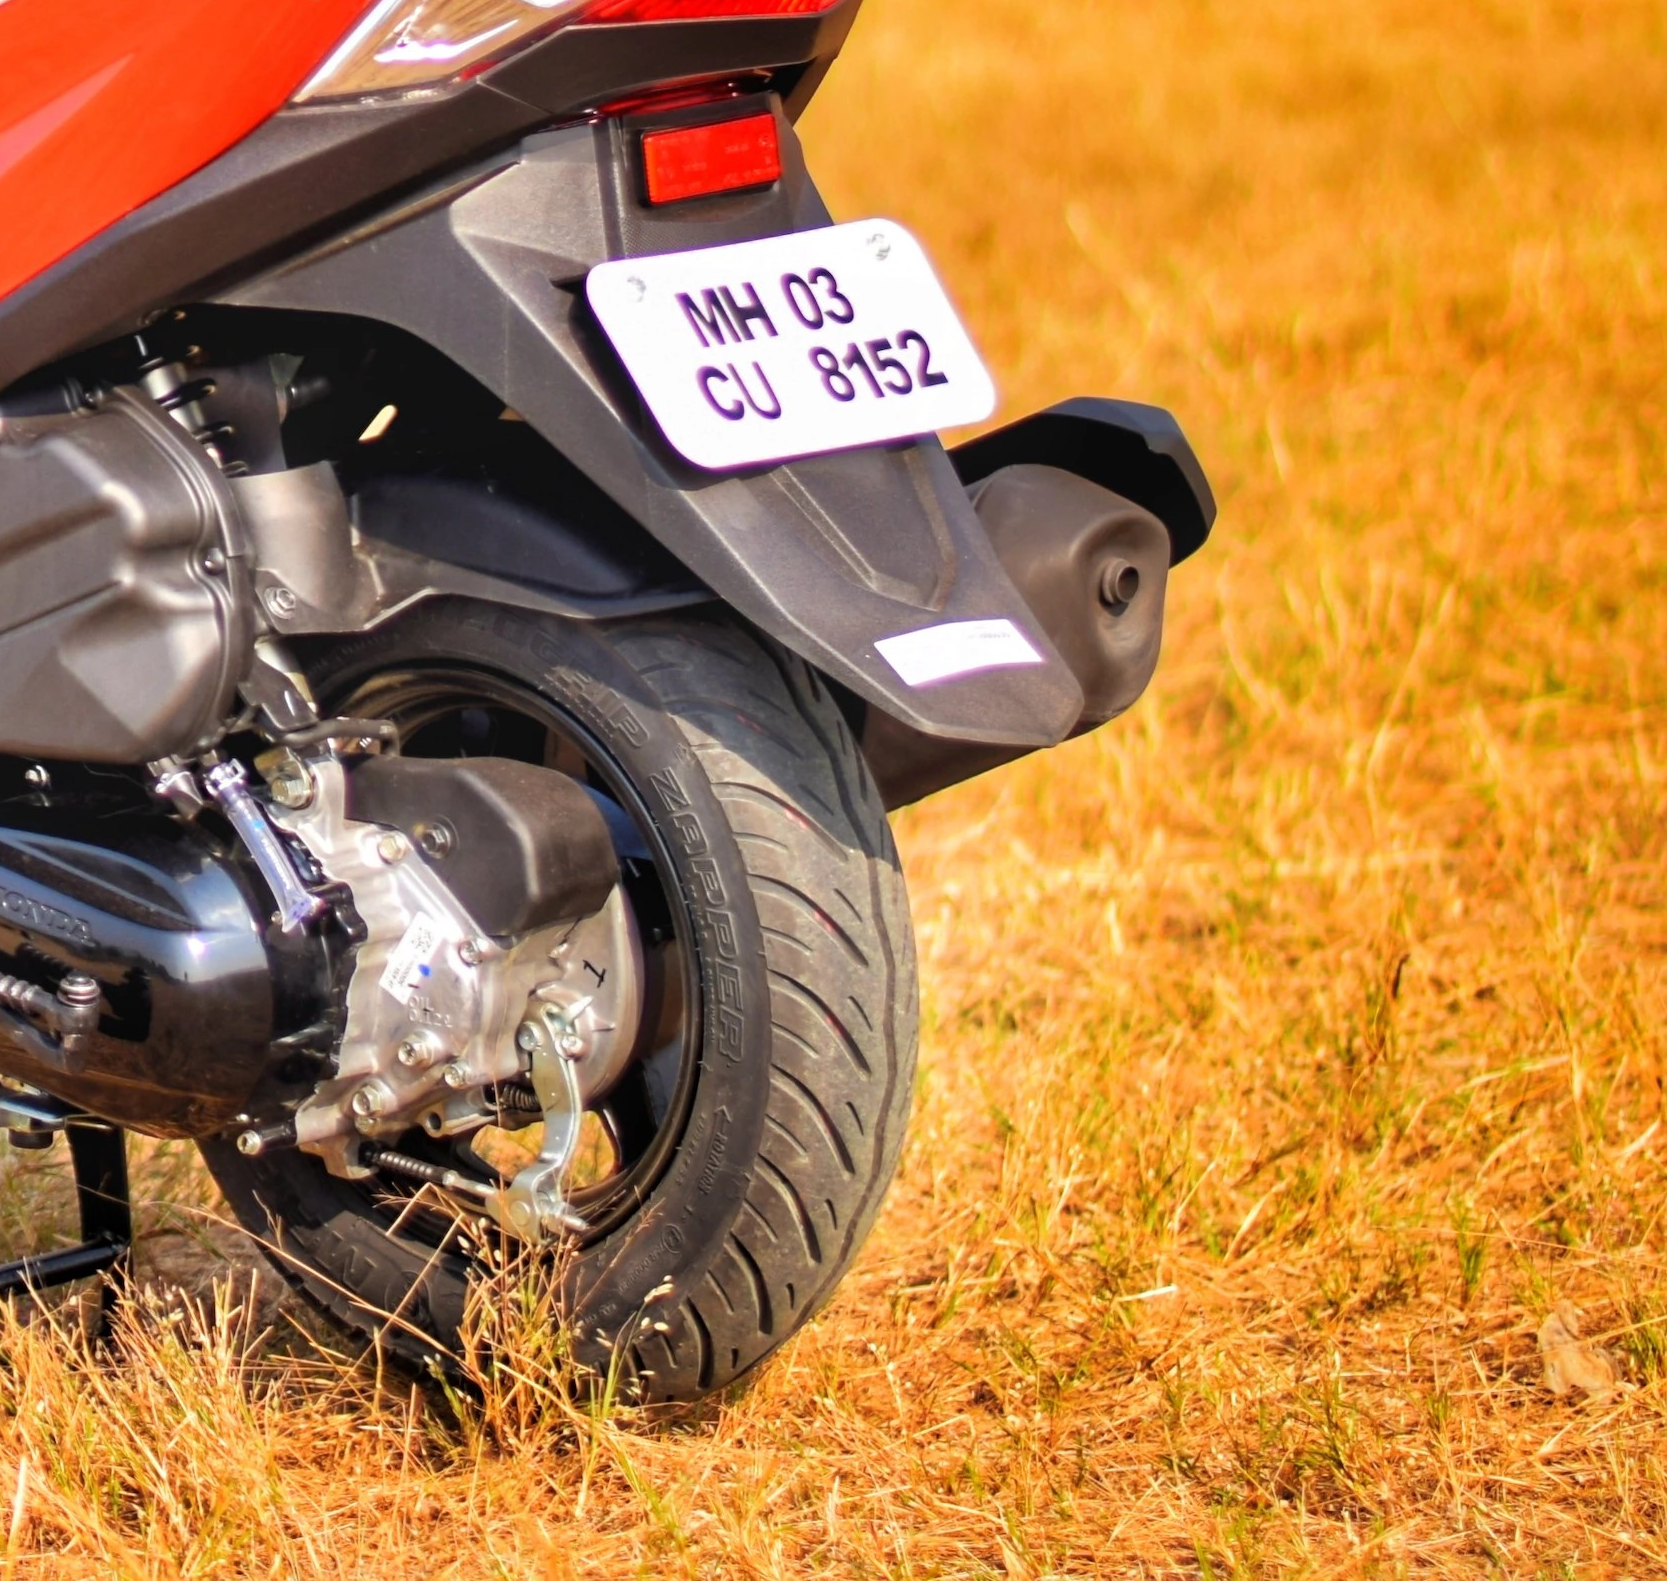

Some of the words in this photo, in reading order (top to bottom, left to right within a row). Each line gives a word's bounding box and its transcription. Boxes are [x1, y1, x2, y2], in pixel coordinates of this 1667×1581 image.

[675, 282, 779, 348] MH
[781, 267, 855, 330] 03
[697, 361, 782, 421] CU
[807, 329, 949, 402] 8152
[648, 765, 745, 1064] ZAPPER
